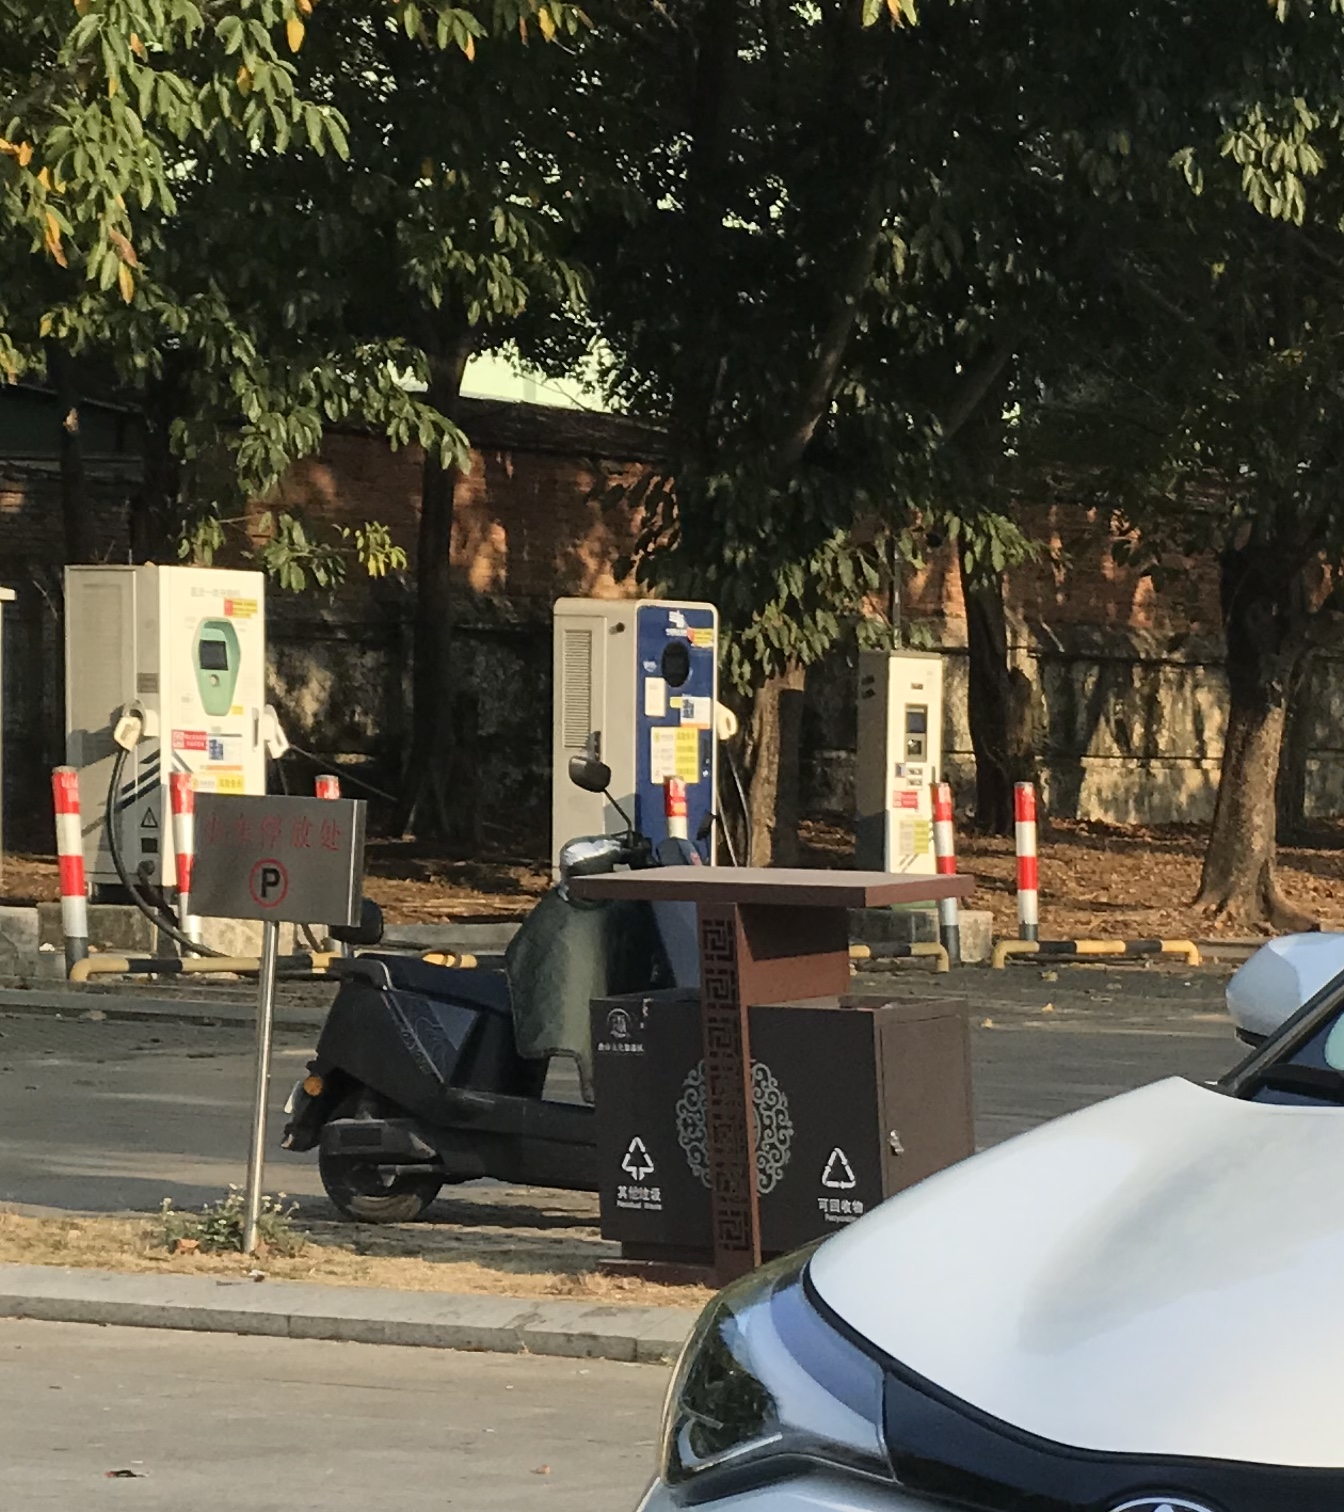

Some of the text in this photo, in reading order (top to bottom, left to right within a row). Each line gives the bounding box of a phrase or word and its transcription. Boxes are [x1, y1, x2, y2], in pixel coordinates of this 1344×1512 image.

[261, 868, 281, 898] P
[817, 1197, 864, 1214] 可回收物
